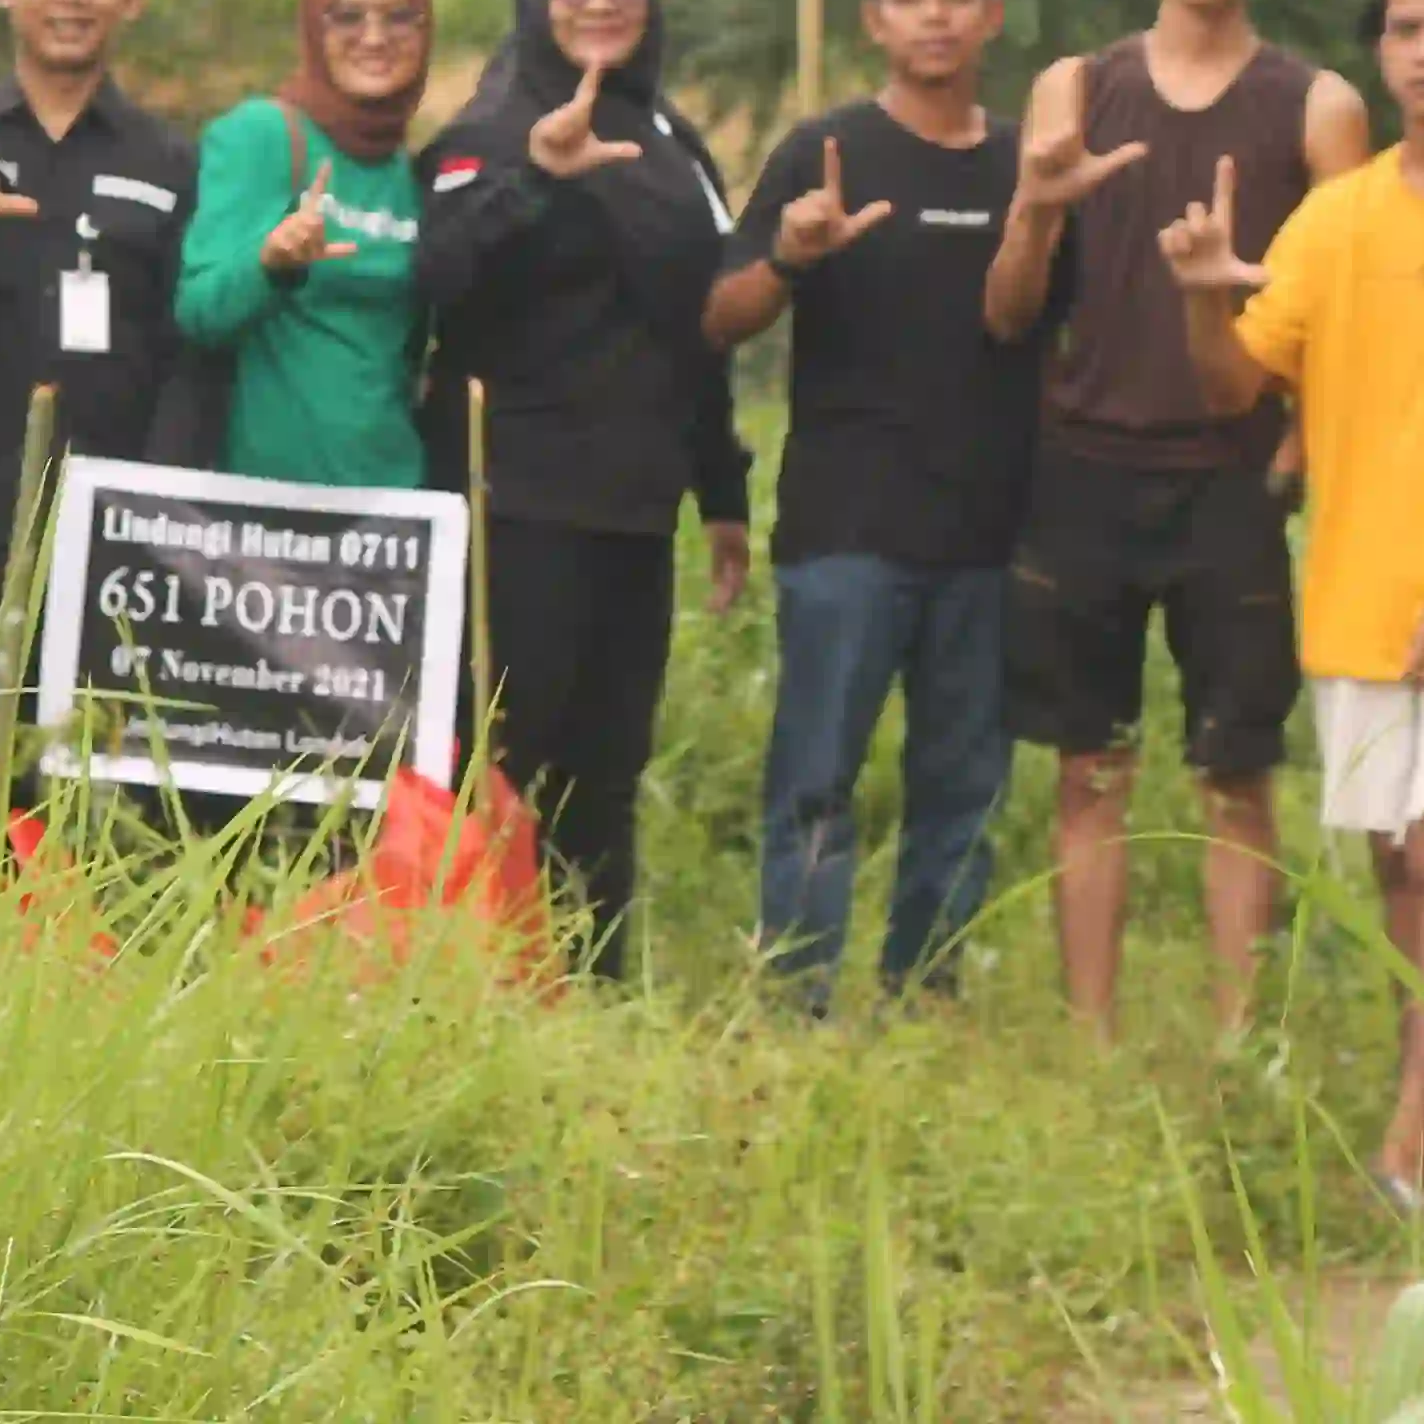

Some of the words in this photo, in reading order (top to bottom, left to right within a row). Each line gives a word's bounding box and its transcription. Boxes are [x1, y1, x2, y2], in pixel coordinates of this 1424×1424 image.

[102, 507, 232, 559] Lindungi
[241, 524, 331, 562] Hutan
[340, 531, 419, 569] 0711
[99, 566, 181, 623] 651
[201, 575, 409, 645] POHON
[160, 648, 304, 693] November
